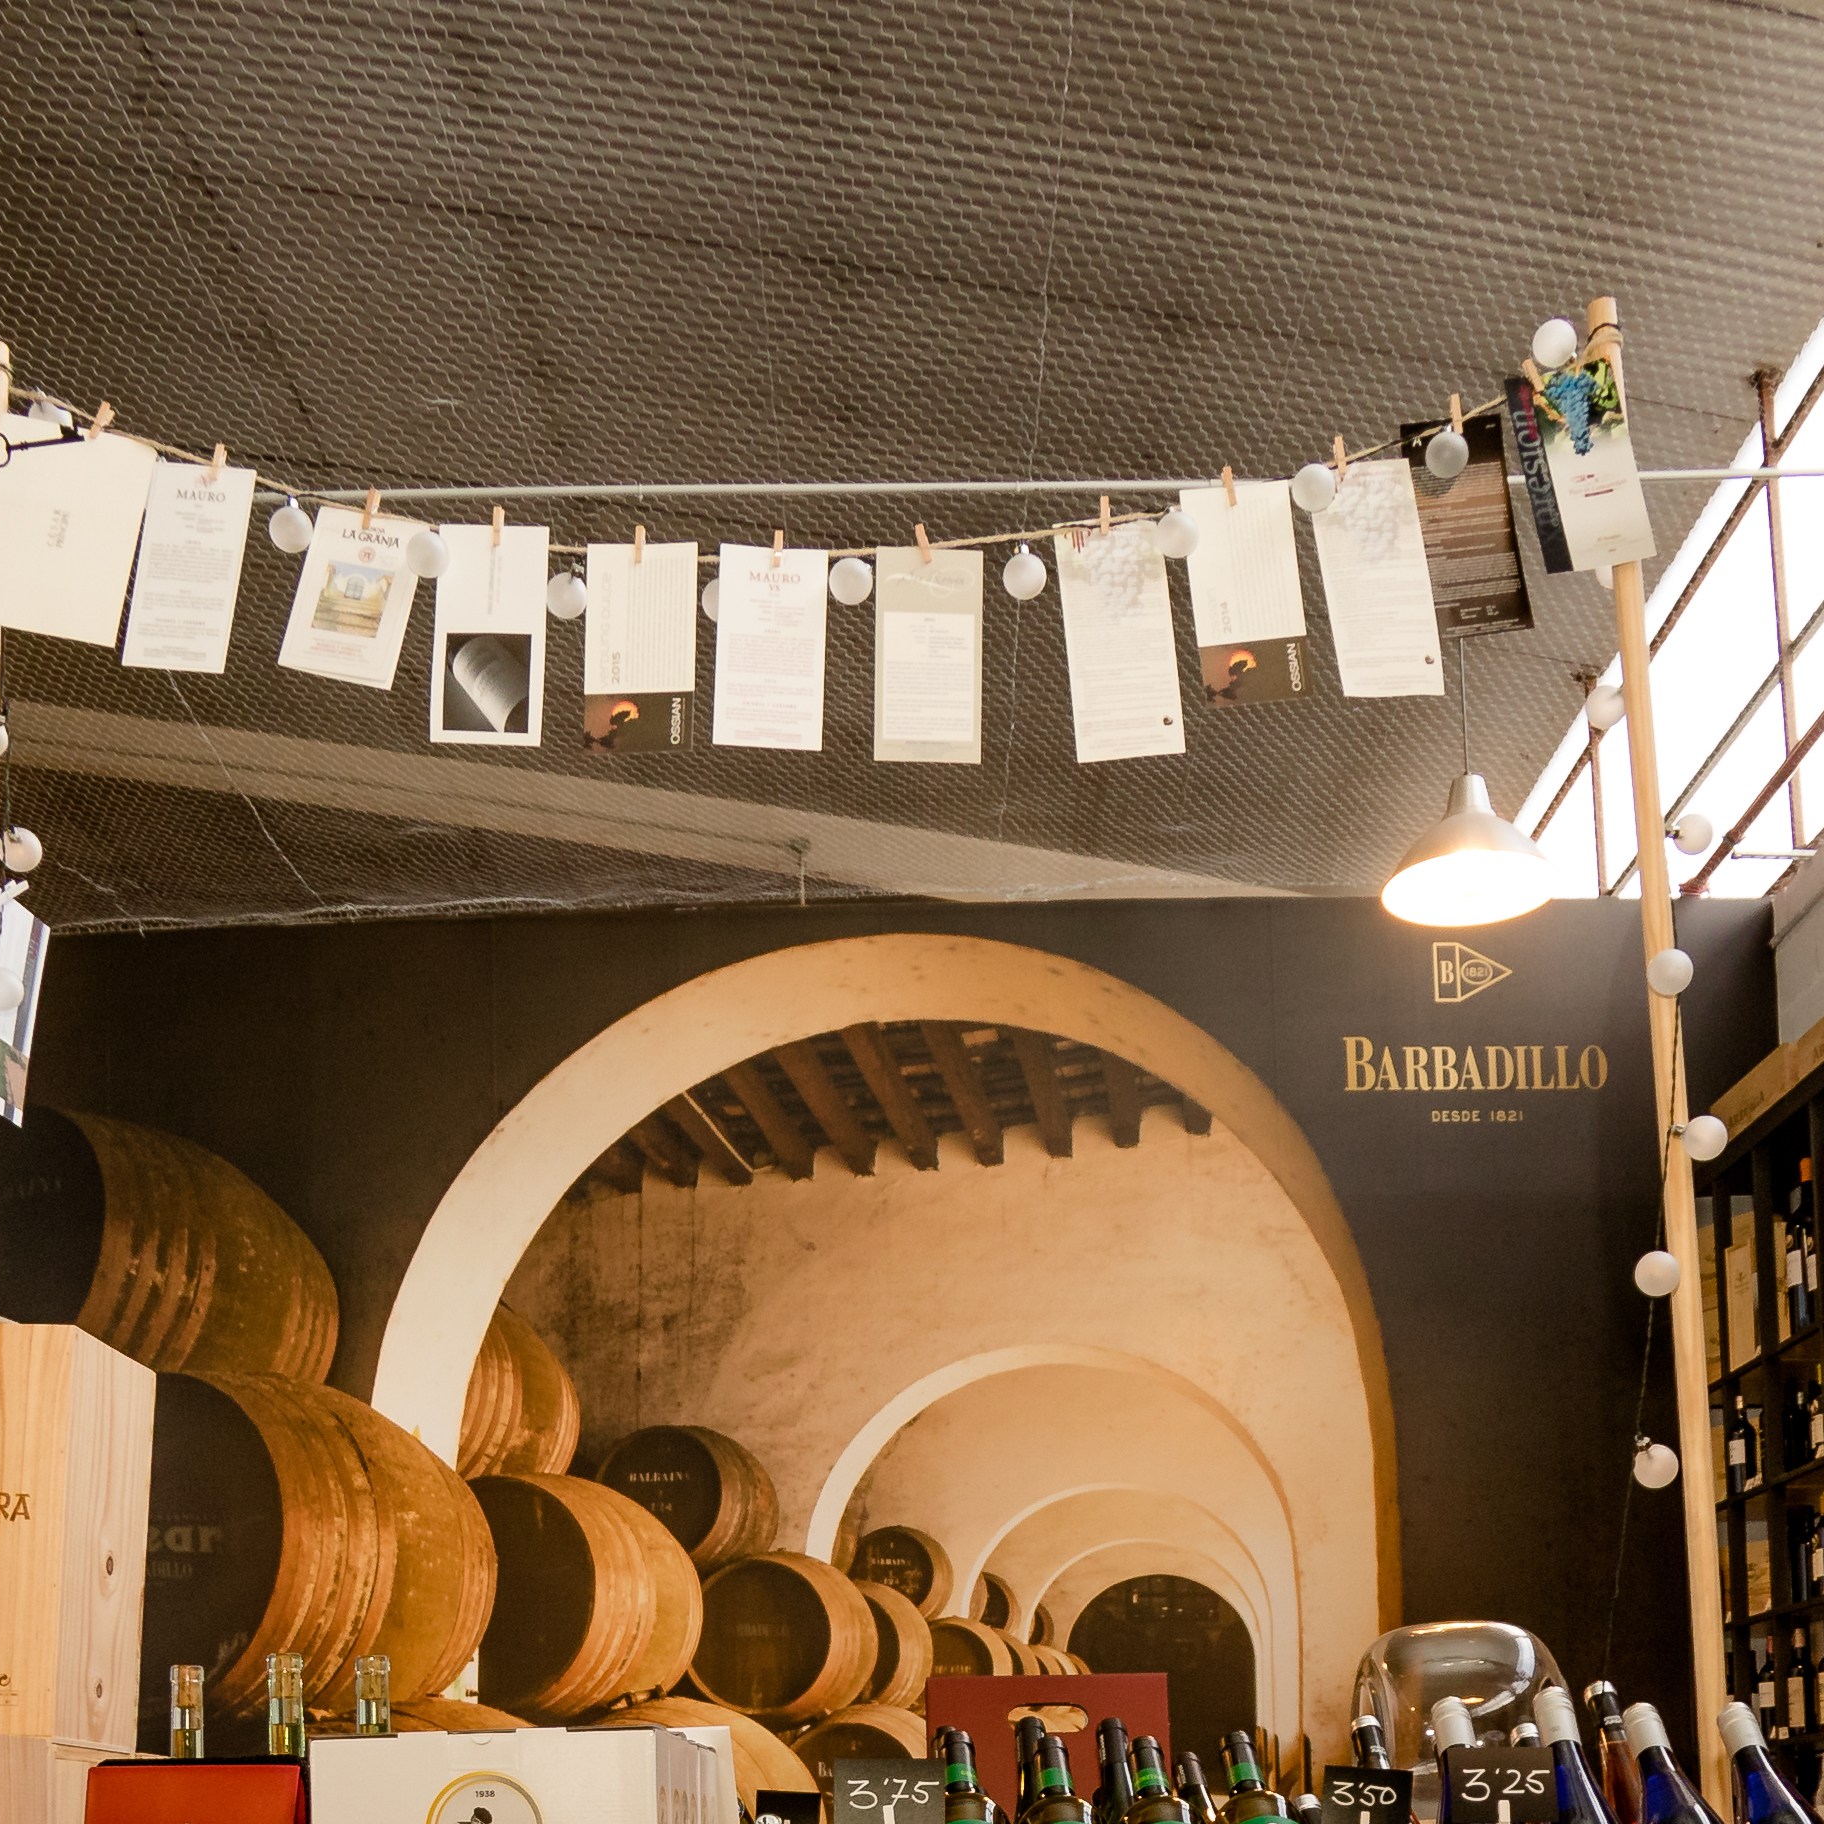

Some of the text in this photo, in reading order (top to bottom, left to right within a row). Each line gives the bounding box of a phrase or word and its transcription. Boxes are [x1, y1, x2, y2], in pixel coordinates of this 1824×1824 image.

[176, 488, 227, 504] MAURO
[342, 527, 358, 541] LA
[357, 530, 401, 550] GRANJA
[749, 571, 802, 585] MAURO
[1220, 601, 1233, 635] 2014
[611, 651, 621, 685] 2015
[1286, 642, 1303, 692] OSSIAN
[670, 697, 682, 745] OSSIAN
[1441, 960, 1455, 985] B
[1343, 1036, 1608, 1093] BARBADILLO
[1431, 1110, 1524, 1123] DESDE 1821
[474, 1789, 496, 1799] 1938
